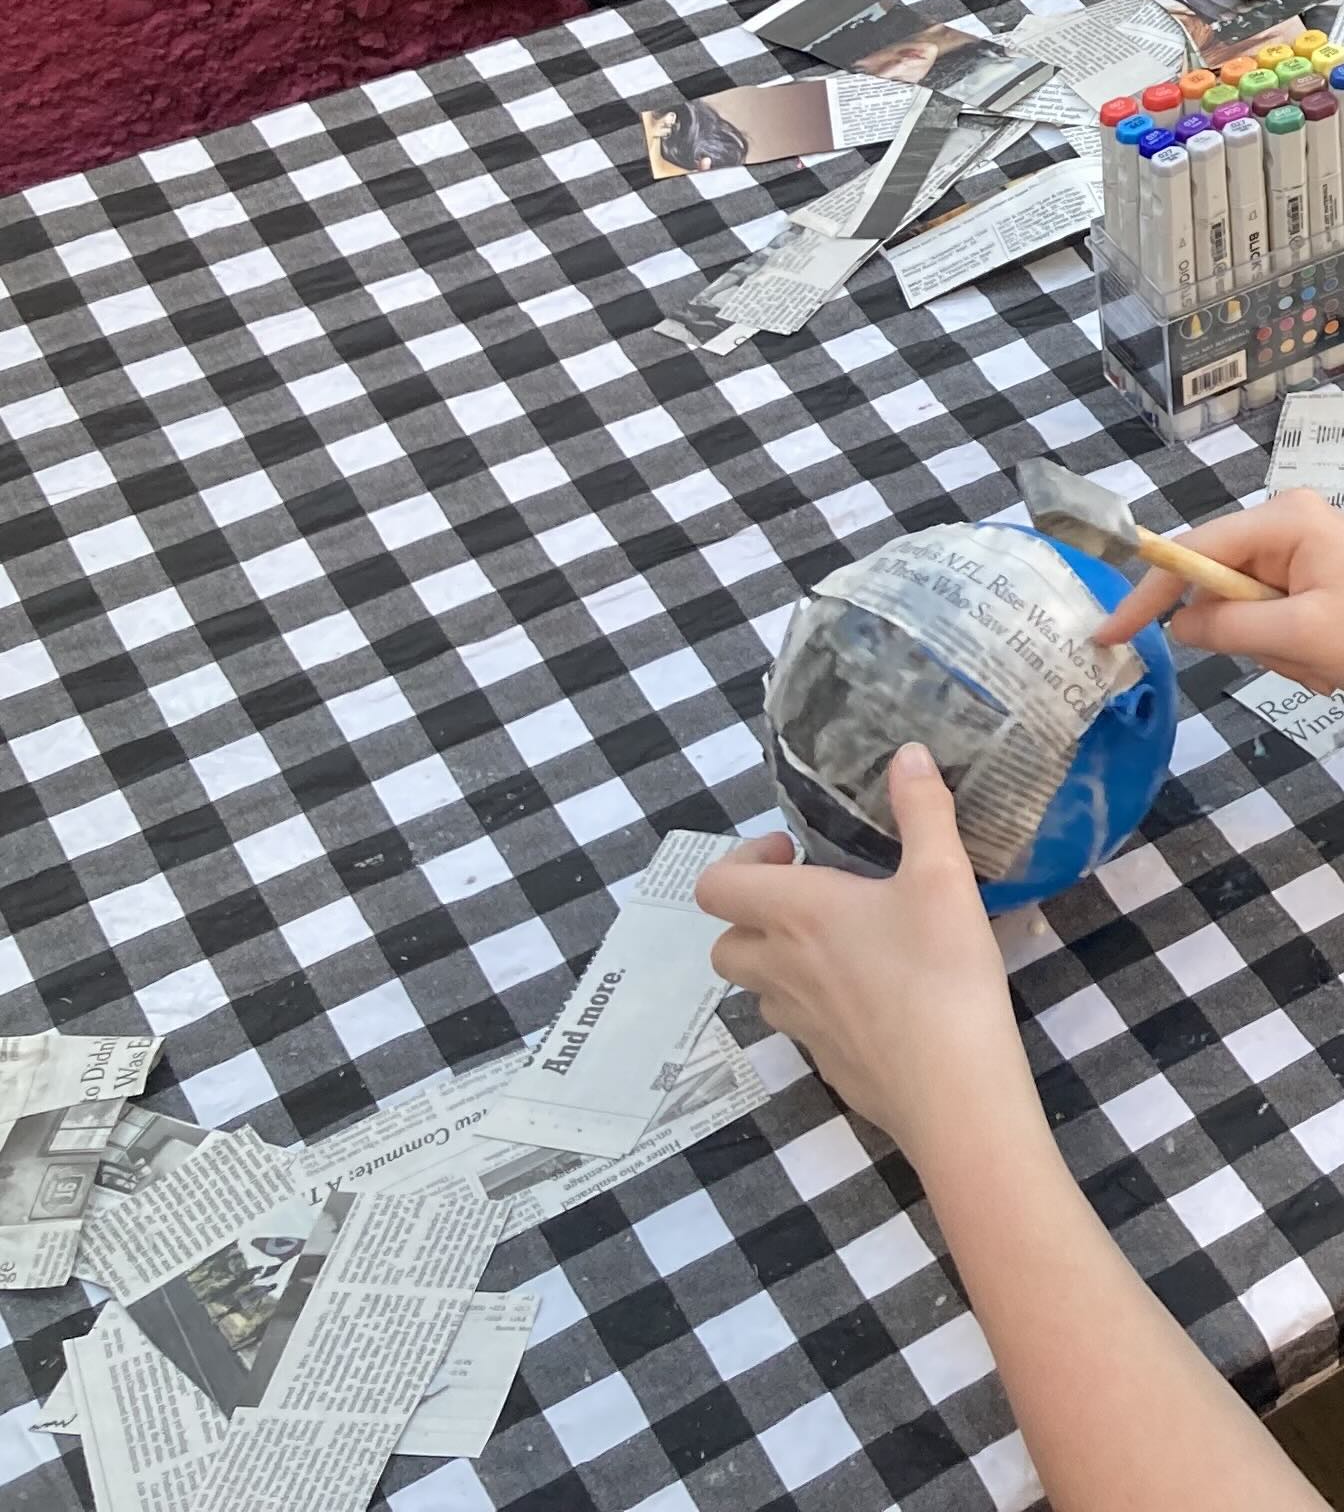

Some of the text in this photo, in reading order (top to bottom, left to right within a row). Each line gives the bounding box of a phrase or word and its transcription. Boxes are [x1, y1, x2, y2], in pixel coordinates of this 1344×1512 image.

[932, 574, 971, 609] Who
[969, 601, 1010, 635] Saw
[1005, 629, 1046, 672] Him
[1043, 669, 1064, 689] in
[987, 573, 1026, 612] Rise
[1027, 604, 1060, 643] Was
[1059, 638, 1087, 667] No
[542, 1029, 589, 1076] And
[576, 967, 627, 1034] more.
[113, 1050, 146, 1091] Was
[455, 1107, 488, 1131] ew
[349, 1126, 451, 1182] Commute:
[619, 1159, 646, 1178] who
